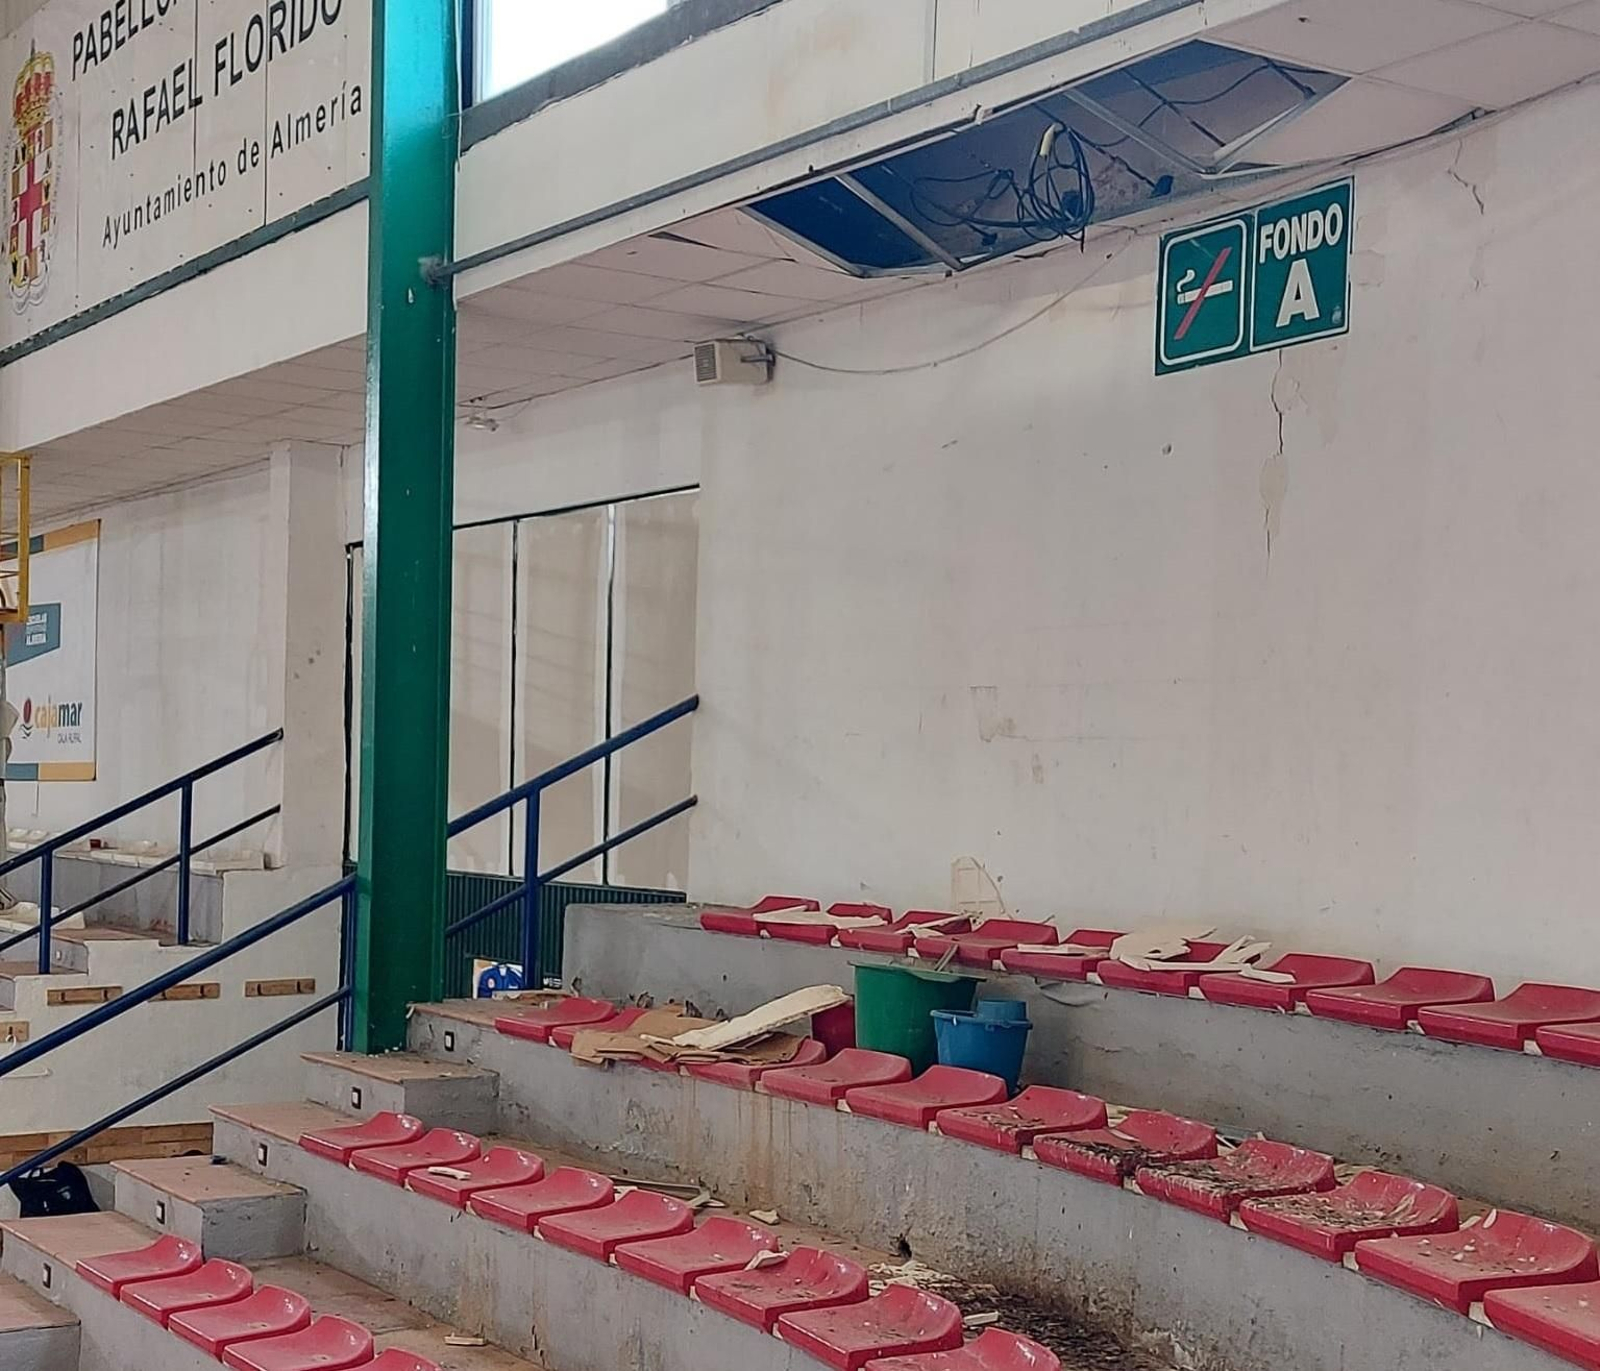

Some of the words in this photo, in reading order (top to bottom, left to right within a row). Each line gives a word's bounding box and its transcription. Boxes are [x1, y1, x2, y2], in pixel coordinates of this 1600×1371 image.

[72, 0, 177, 81] PABELL
[111, 58, 203, 160] RAFAEL
[103, 160, 226, 249] Ayuntamiento
[237, 138, 260, 175] de
[270, 80, 362, 159] Almería
[1259, 203, 1343, 264] FONDO
[1275, 258, 1320, 328] A
[35, 696, 83, 739] cajamar
